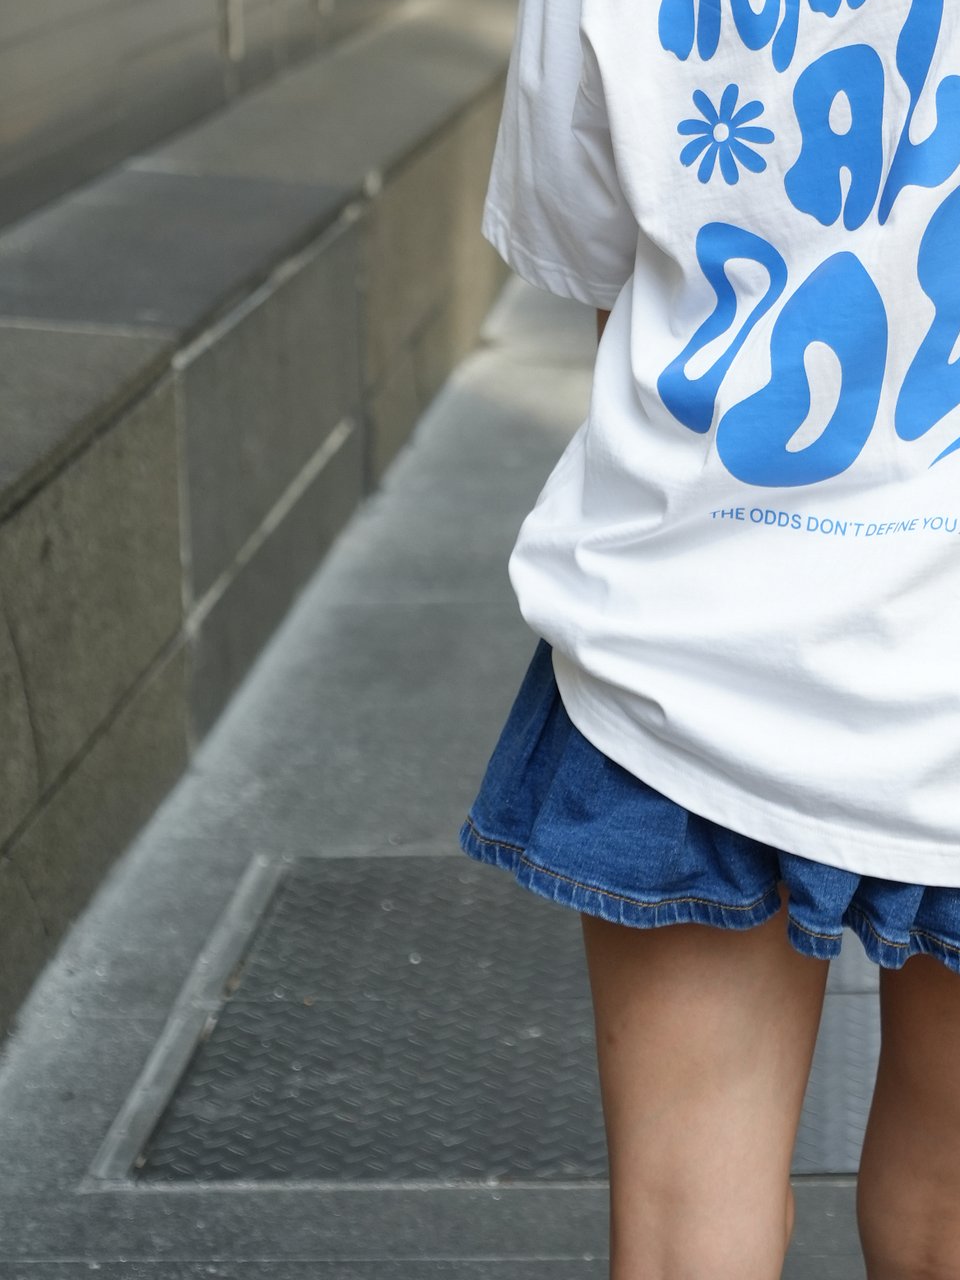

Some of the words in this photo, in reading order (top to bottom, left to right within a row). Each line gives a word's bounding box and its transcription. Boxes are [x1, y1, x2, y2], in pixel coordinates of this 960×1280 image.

[710, 508, 745, 520] THE
[749, 508, 801, 529] ODDS
[806, 516, 864, 536] DON'T
[866, 518, 919, 536] DEFINE
